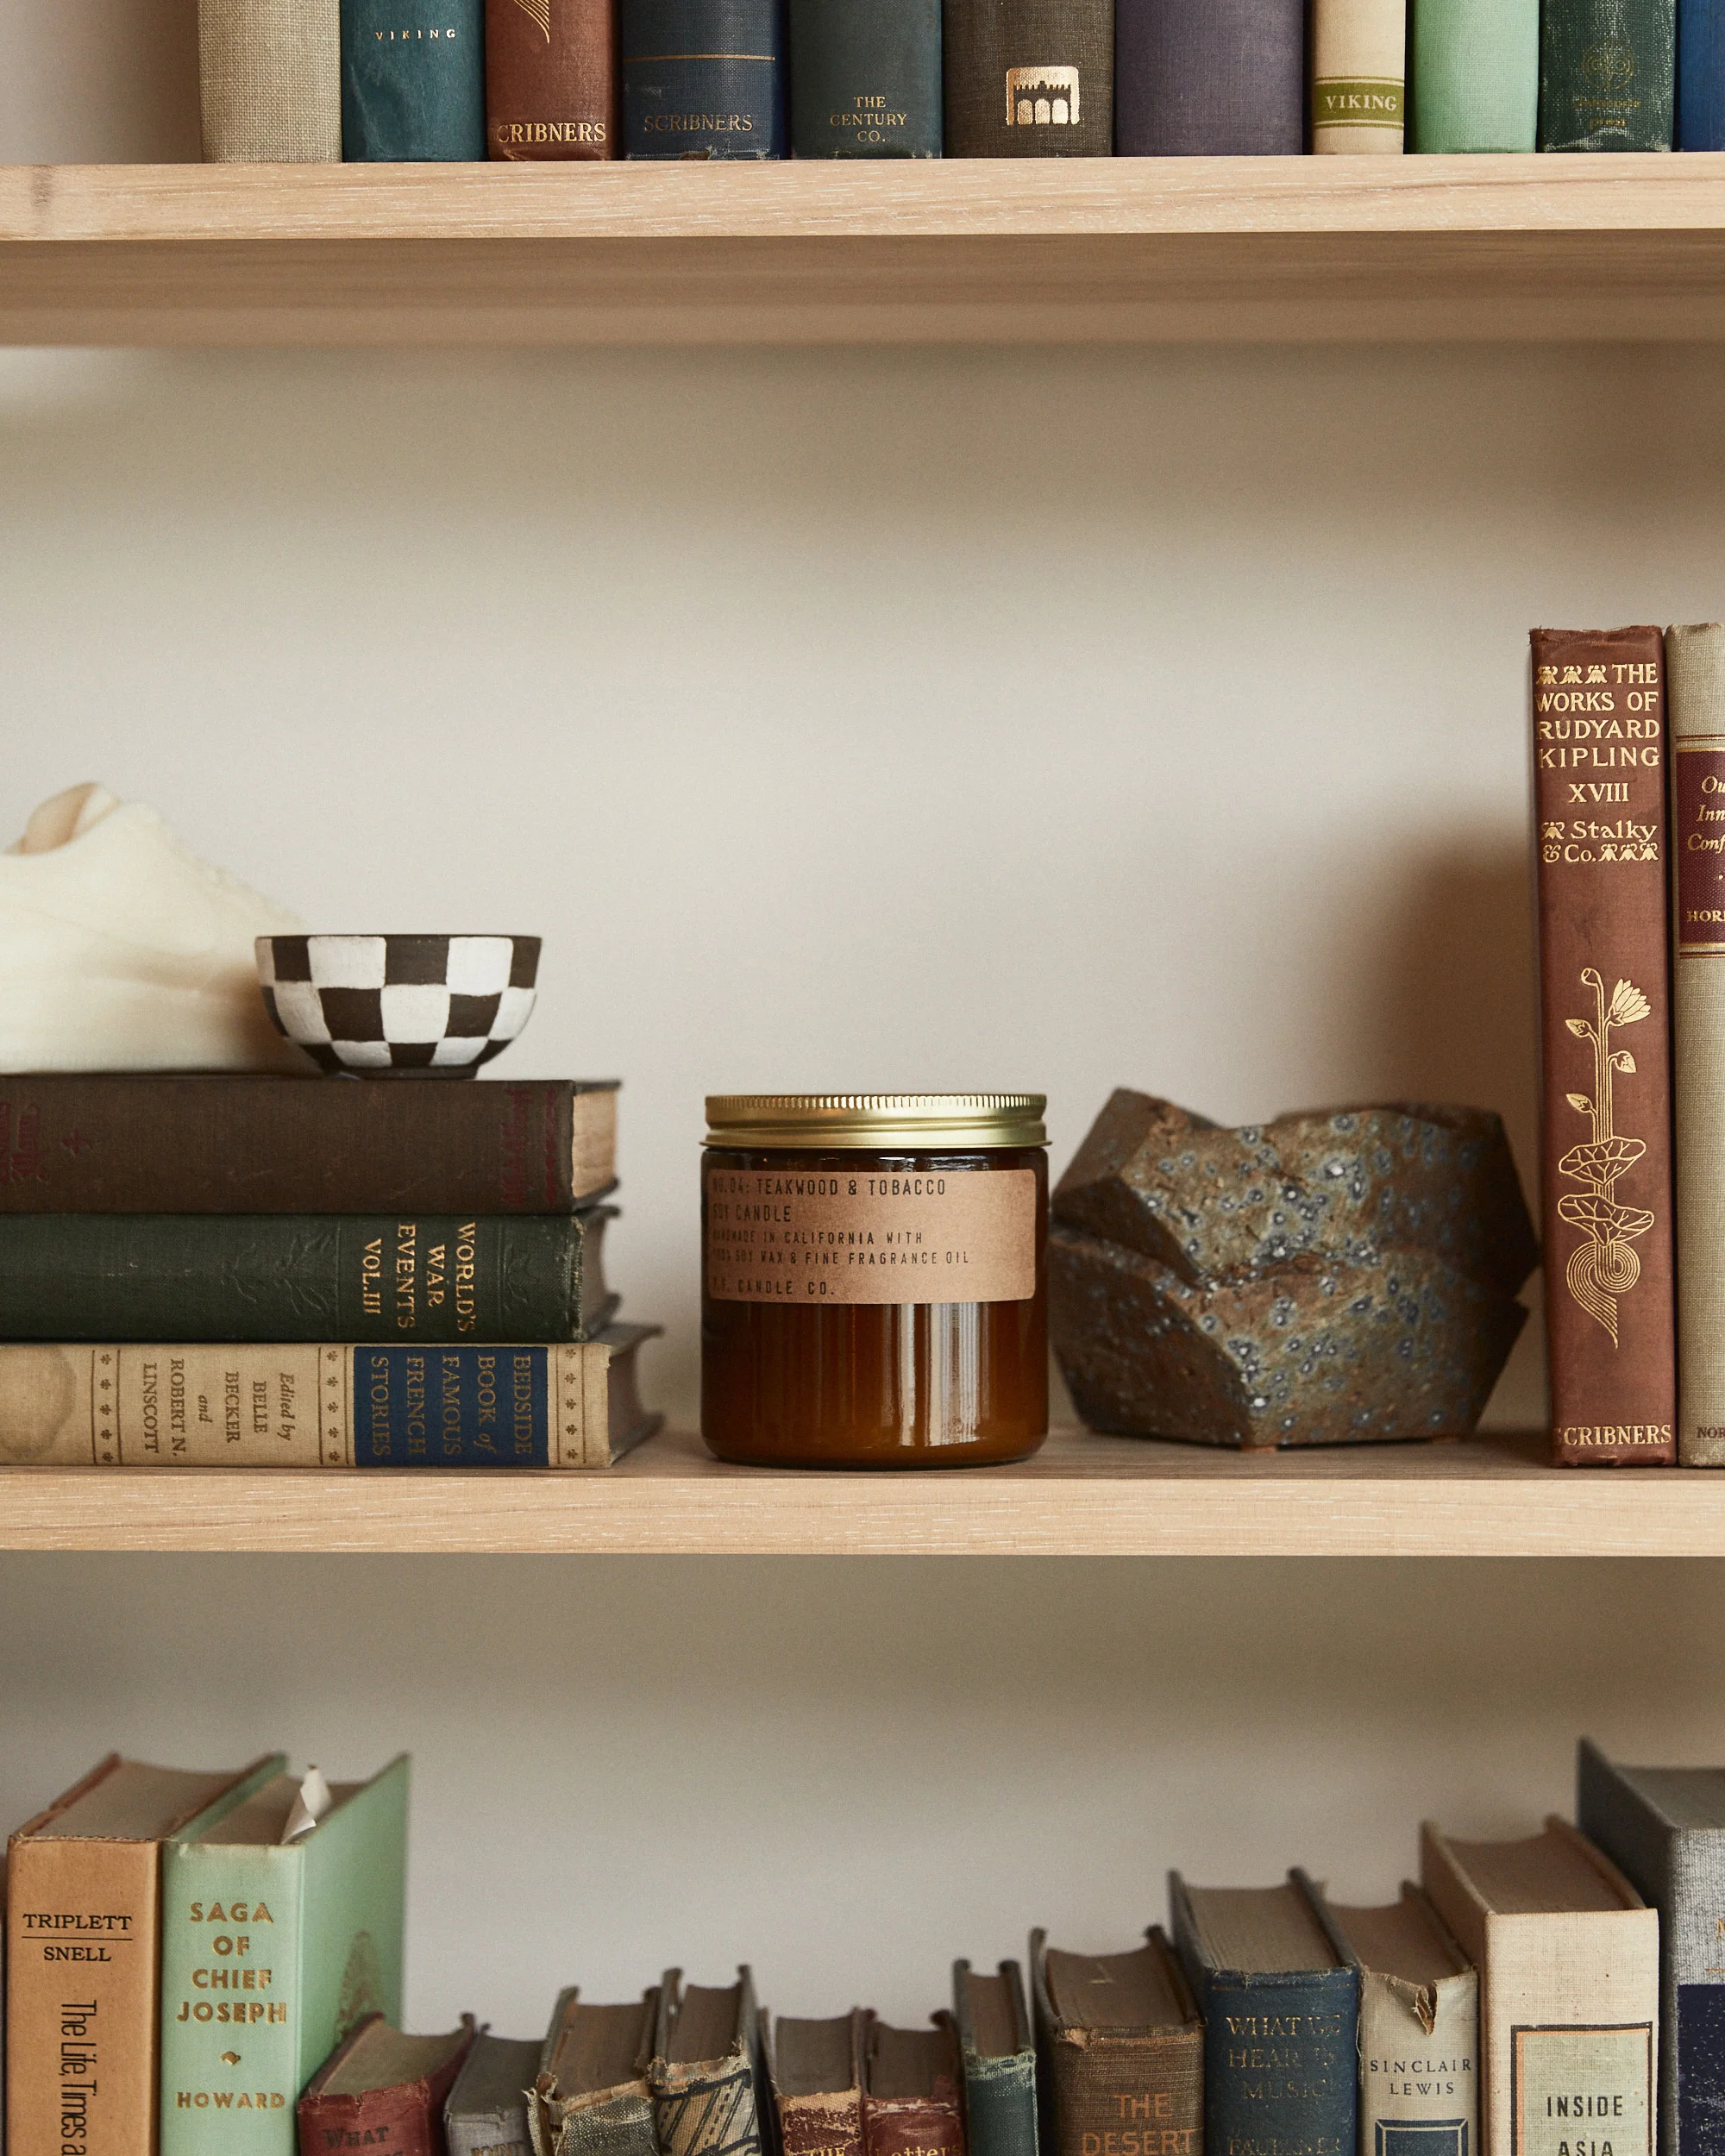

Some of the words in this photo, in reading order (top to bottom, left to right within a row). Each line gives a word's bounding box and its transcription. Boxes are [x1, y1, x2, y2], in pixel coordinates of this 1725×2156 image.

[375, 28, 455, 41] VIKING
[853, 96, 887, 108] THE
[1325, 94, 1398, 111] VIKING
[644, 114, 753, 131] SCRIBNERS
[830, 113, 908, 126] CENTURY
[856, 130, 887, 142] CO.
[1611, 662, 1659, 684] THE
[1536, 691, 1615, 712] WORKS
[1627, 691, 1659, 711] OF
[1538, 719, 1661, 740] RUDYARD
[1540, 746, 1660, 768] KIPLING
[1568, 782, 1629, 803] XVIII
[1570, 820, 1658, 843] Stalky
[1686, 910, 1725, 922] HOR
[756, 1178, 840, 1195] TEAKWOOD
[848, 1179, 857, 1195] &
[869, 1179, 945, 1195] TOBACCO
[736, 1204, 792, 1223] CANDLE
[763, 1231, 775, 1243] IN
[784, 1231, 875, 1244] CALIFORNIA
[887, 1232, 923, 1244] WITH
[761, 1251, 783, 1264] WAX
[805, 1251, 838, 1265] FINE
[849, 1251, 938, 1265] FRAGRANCE
[945, 1251, 969, 1264] OIL
[397, 1223, 416, 1329] EVENTS
[427, 1244, 446, 1308] WAR
[455, 1221, 476, 1332] WORLD'S
[737, 1279, 793, 1294] CANDLE
[807, 1282, 835, 1295] CO.
[170, 1358, 186, 1433] ROBERT
[279, 1372, 296, 1420] Edited
[477, 1355, 497, 1426] BOOK
[142, 1363, 160, 1454] LINSCOTT
[198, 1395, 214, 1424] and
[224, 1371, 241, 1444] BECKER
[253, 1381, 268, 1433] BELLE
[370, 1355, 392, 1457] STORIES
[406, 1355, 427, 1455] FRENCH
[442, 1355, 461, 1456] FAMOUS
[513, 1355, 533, 1455] BEDSIDE
[277, 1424, 296, 1441] by
[474, 1432, 498, 1455] of
[22, 1914, 133, 1930] TRIPLETT
[189, 1902, 274, 1923] SAGA
[44, 1946, 112, 1962] SNELL
[212, 1935, 250, 1957] OF
[191, 1969, 273, 1990] CHIEF
[61, 2000, 97, 2036] The
[176, 2002, 287, 2023] JOSEPH
[1226, 2015, 1302, 2036] WHAT
[58, 2042, 97, 2076] Life,
[1370, 2058, 1473, 2074] SINCLAIR
[1389, 2081, 1455, 2096] LEWIS
[61, 2080, 97, 2139] Times
[176, 2091, 285, 2109] HOWARD
[1114, 2093, 1172, 2119] THE
[1546, 2095, 1623, 2118] INSIDE
[323, 2126, 389, 2148] WHAT
[1082, 2128, 1196, 2156] DESERT
[1557, 2140, 1614, 2156] ASIA
